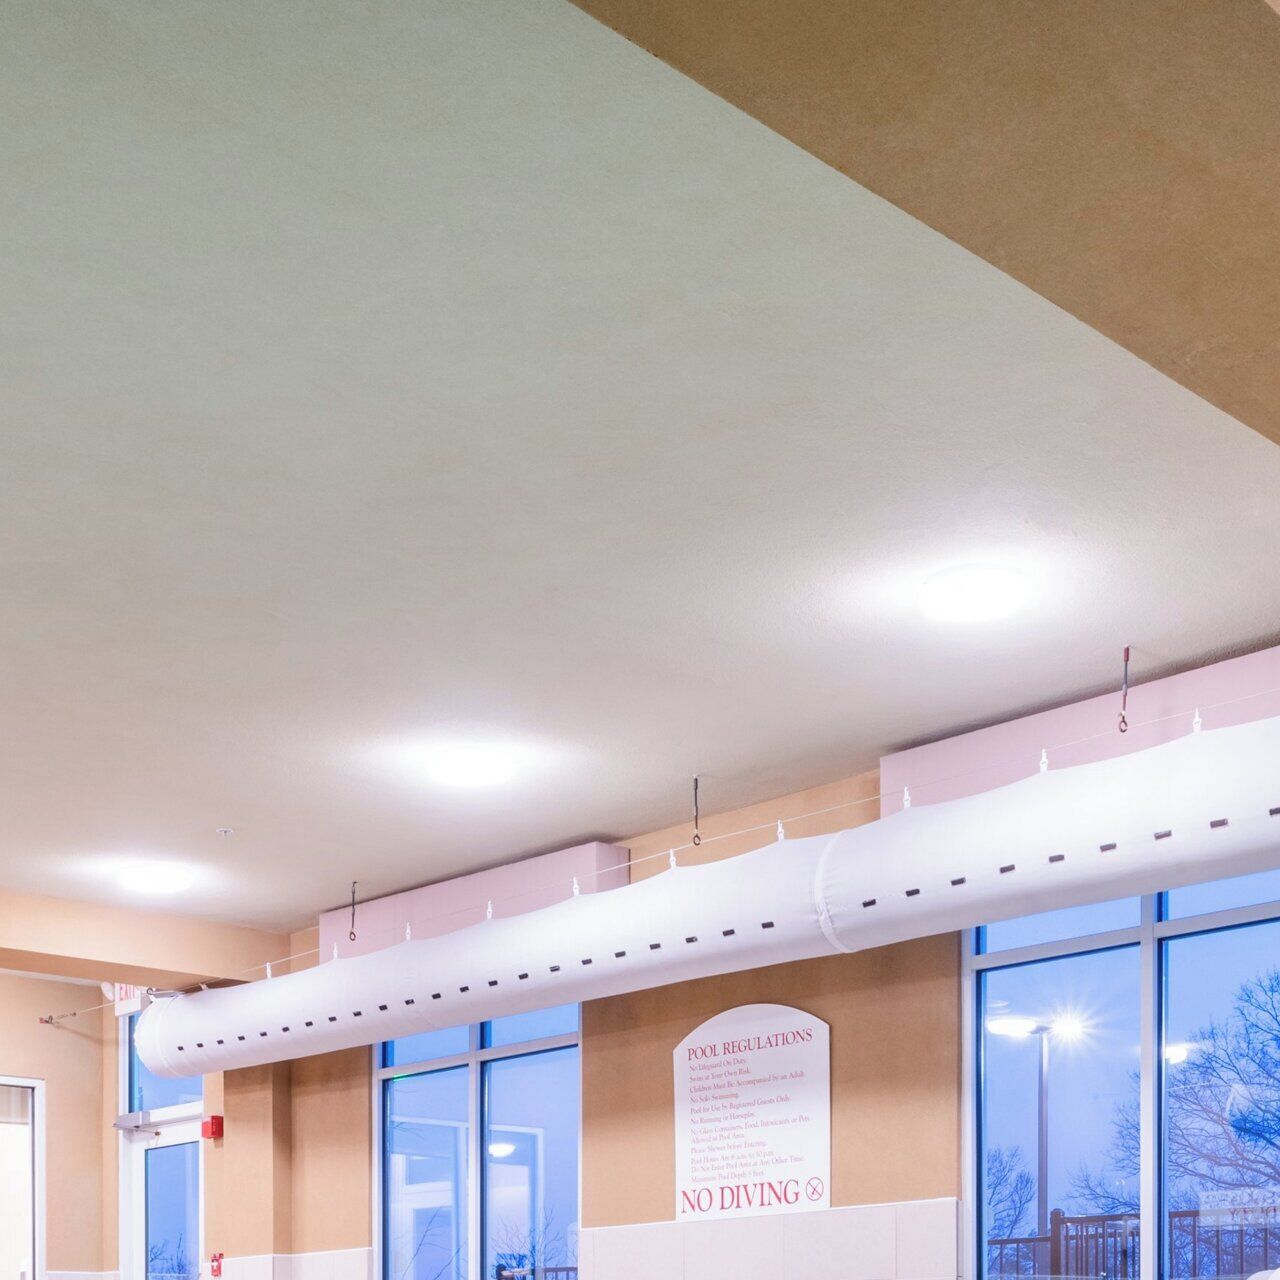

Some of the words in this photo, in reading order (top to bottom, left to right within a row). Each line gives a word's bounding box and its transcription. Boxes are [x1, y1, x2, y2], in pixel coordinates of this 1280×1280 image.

[688, 1044, 719, 1061] POOL
[723, 1028, 812, 1055] REGULATIONS
[681, 1188, 713, 1213] NO
[720, 1179, 800, 1210] DIVING
